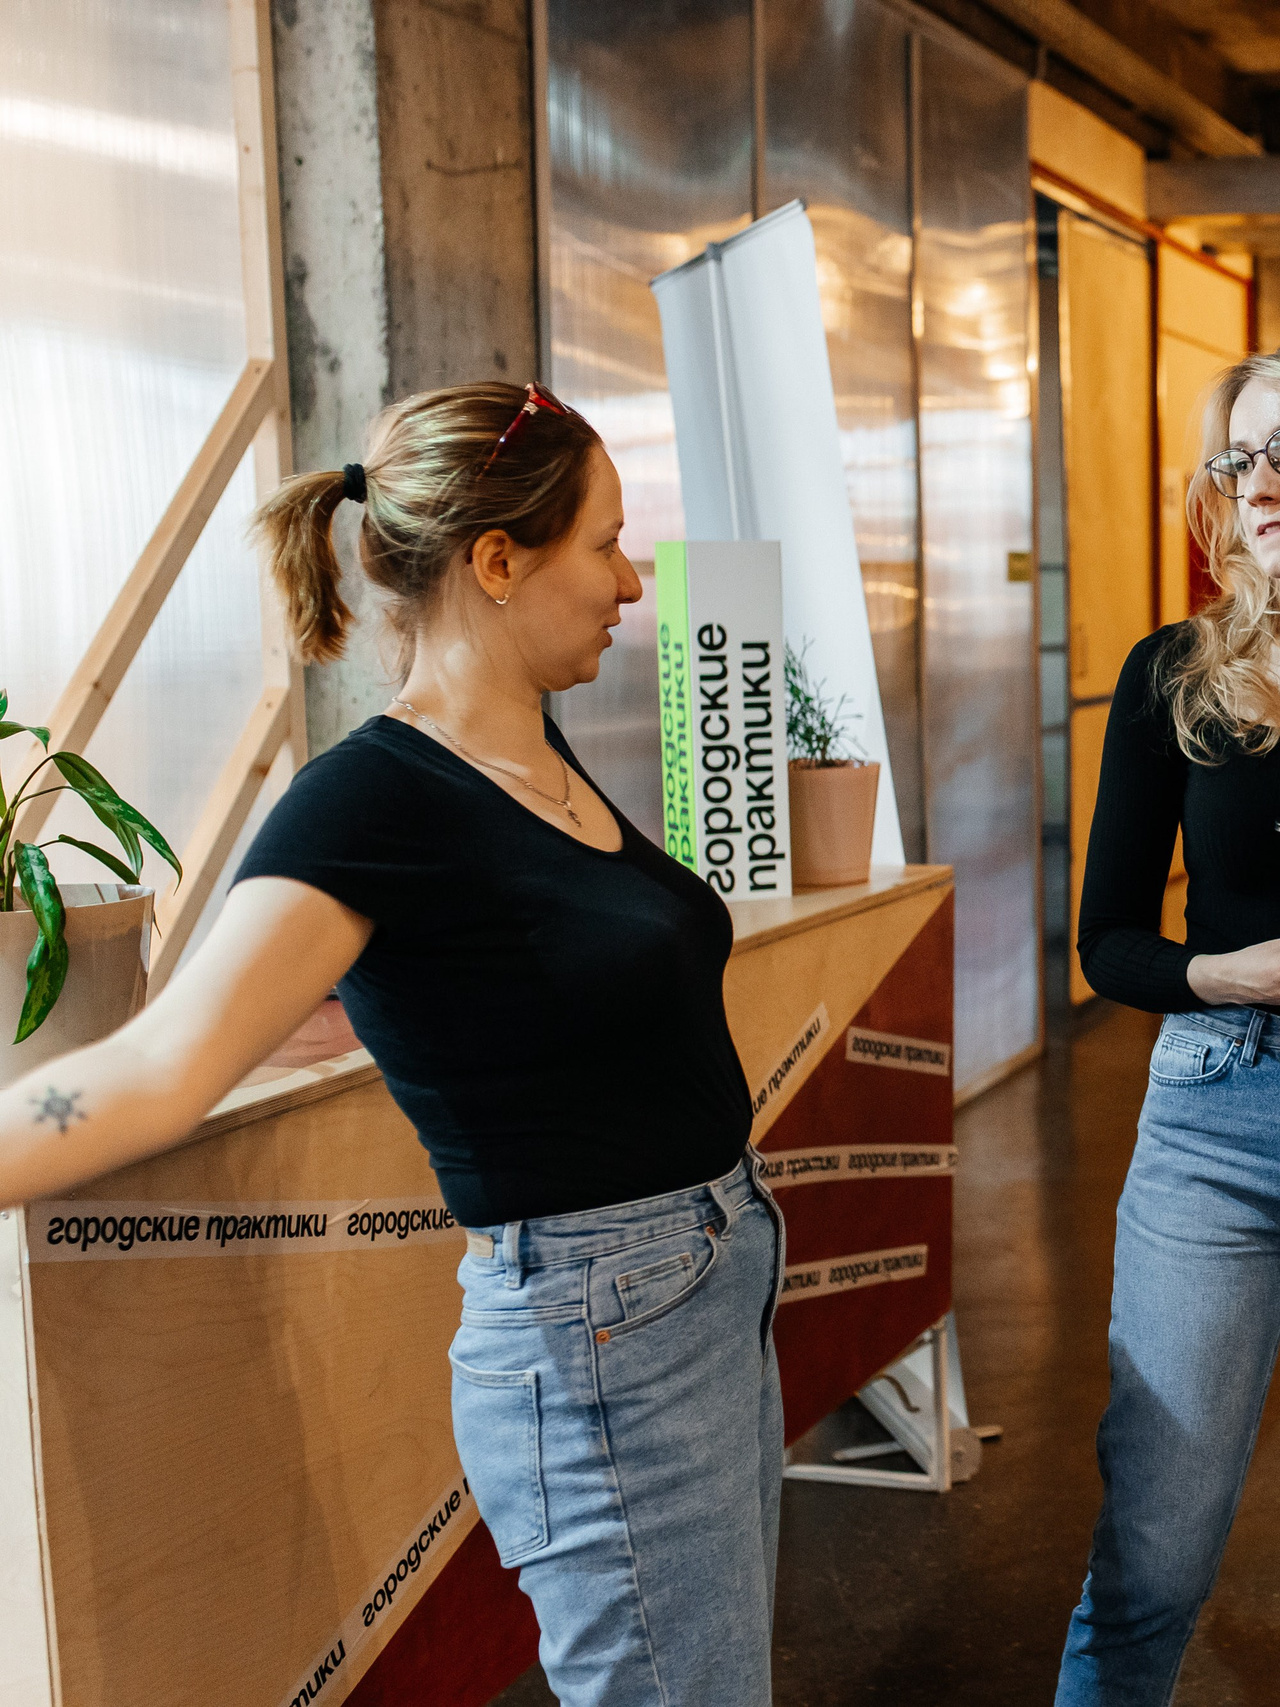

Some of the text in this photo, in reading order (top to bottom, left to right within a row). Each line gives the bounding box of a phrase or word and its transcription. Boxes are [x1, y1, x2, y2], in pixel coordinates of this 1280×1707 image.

[660, 622, 679, 858] ородские
[674, 642, 693, 865] рактики
[697, 622, 743, 893] городские
[741, 641, 785, 892] практики
[47, 1208, 455, 1252] городские практики городские
[289, 1490, 461, 1707] тики городские
